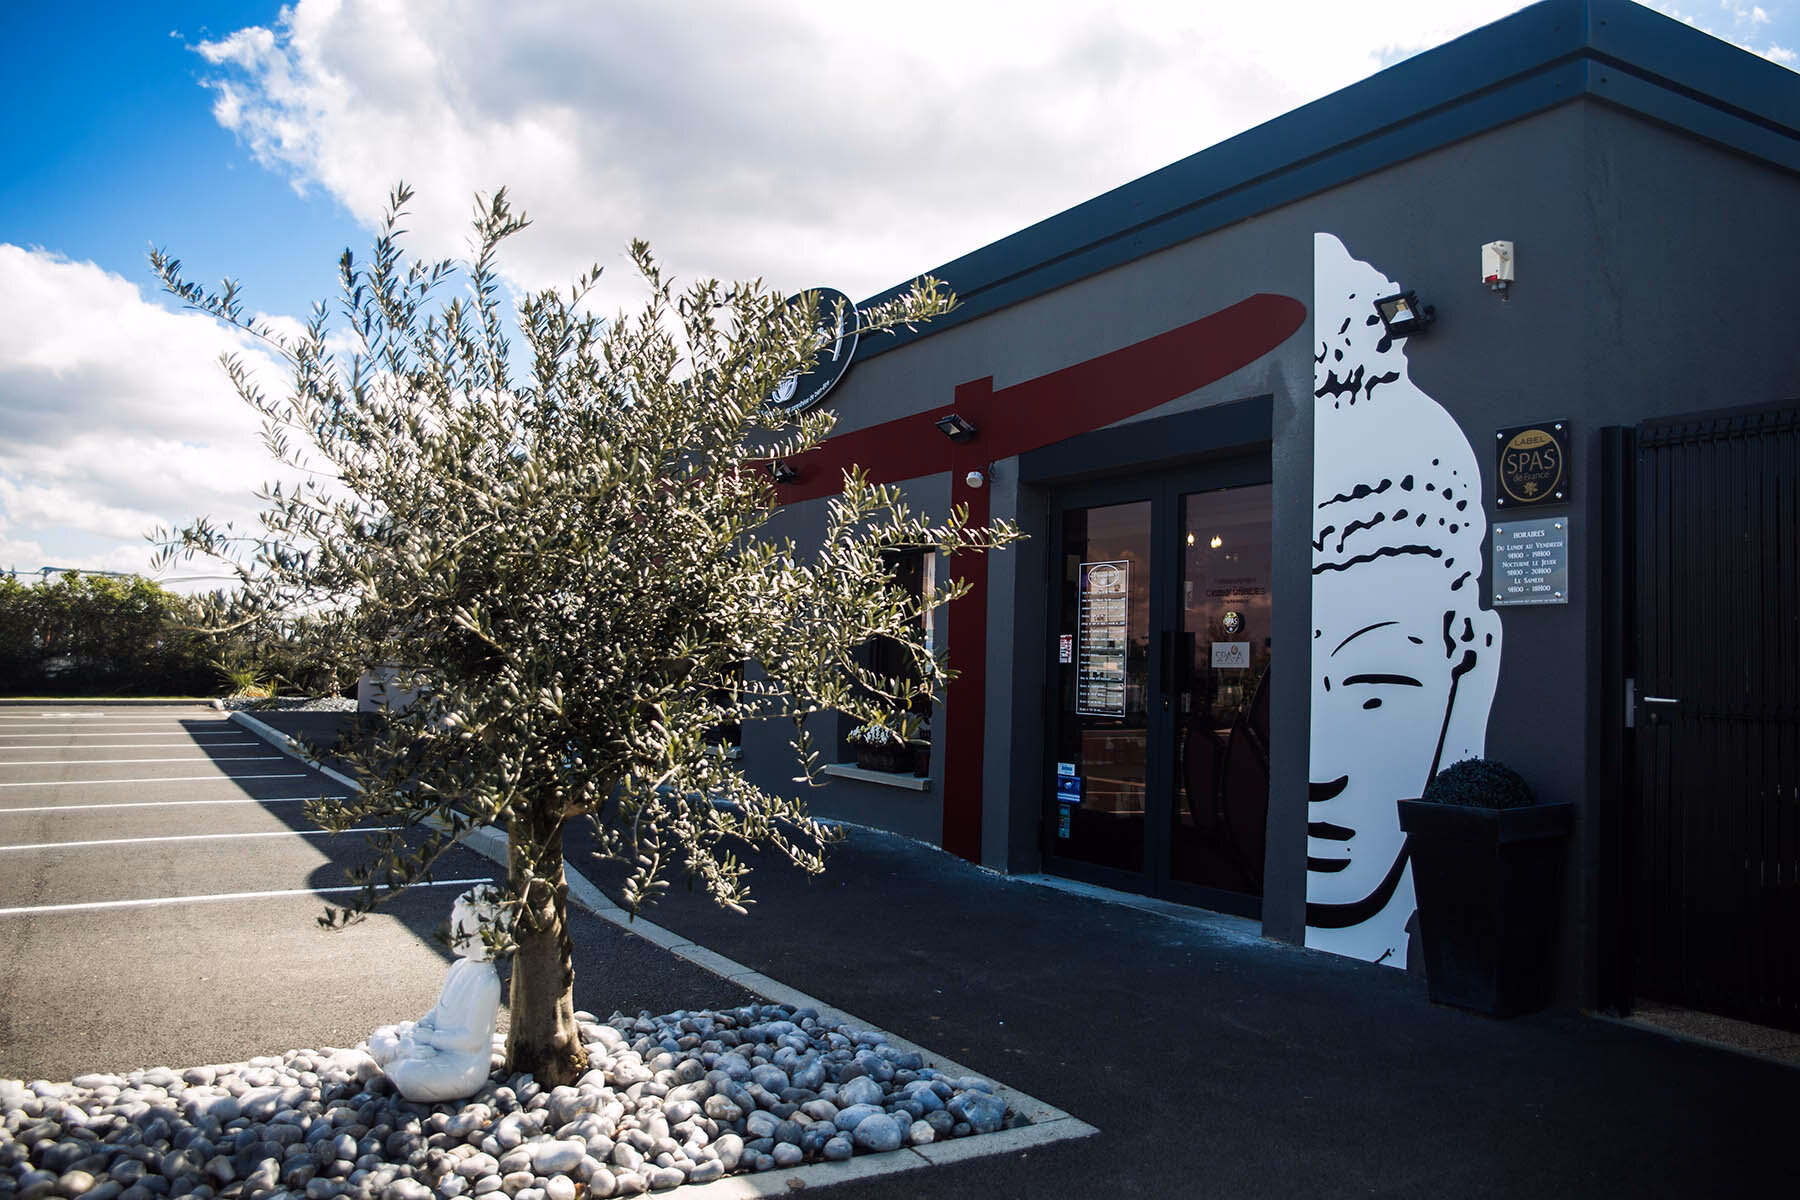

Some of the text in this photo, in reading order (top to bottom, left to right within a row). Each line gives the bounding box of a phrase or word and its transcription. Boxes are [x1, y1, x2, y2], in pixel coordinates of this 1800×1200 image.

[1514, 436, 1545, 447] LABEL
[1507, 448, 1555, 474] SPAS
[1513, 530, 1545, 539] HORAIRES
